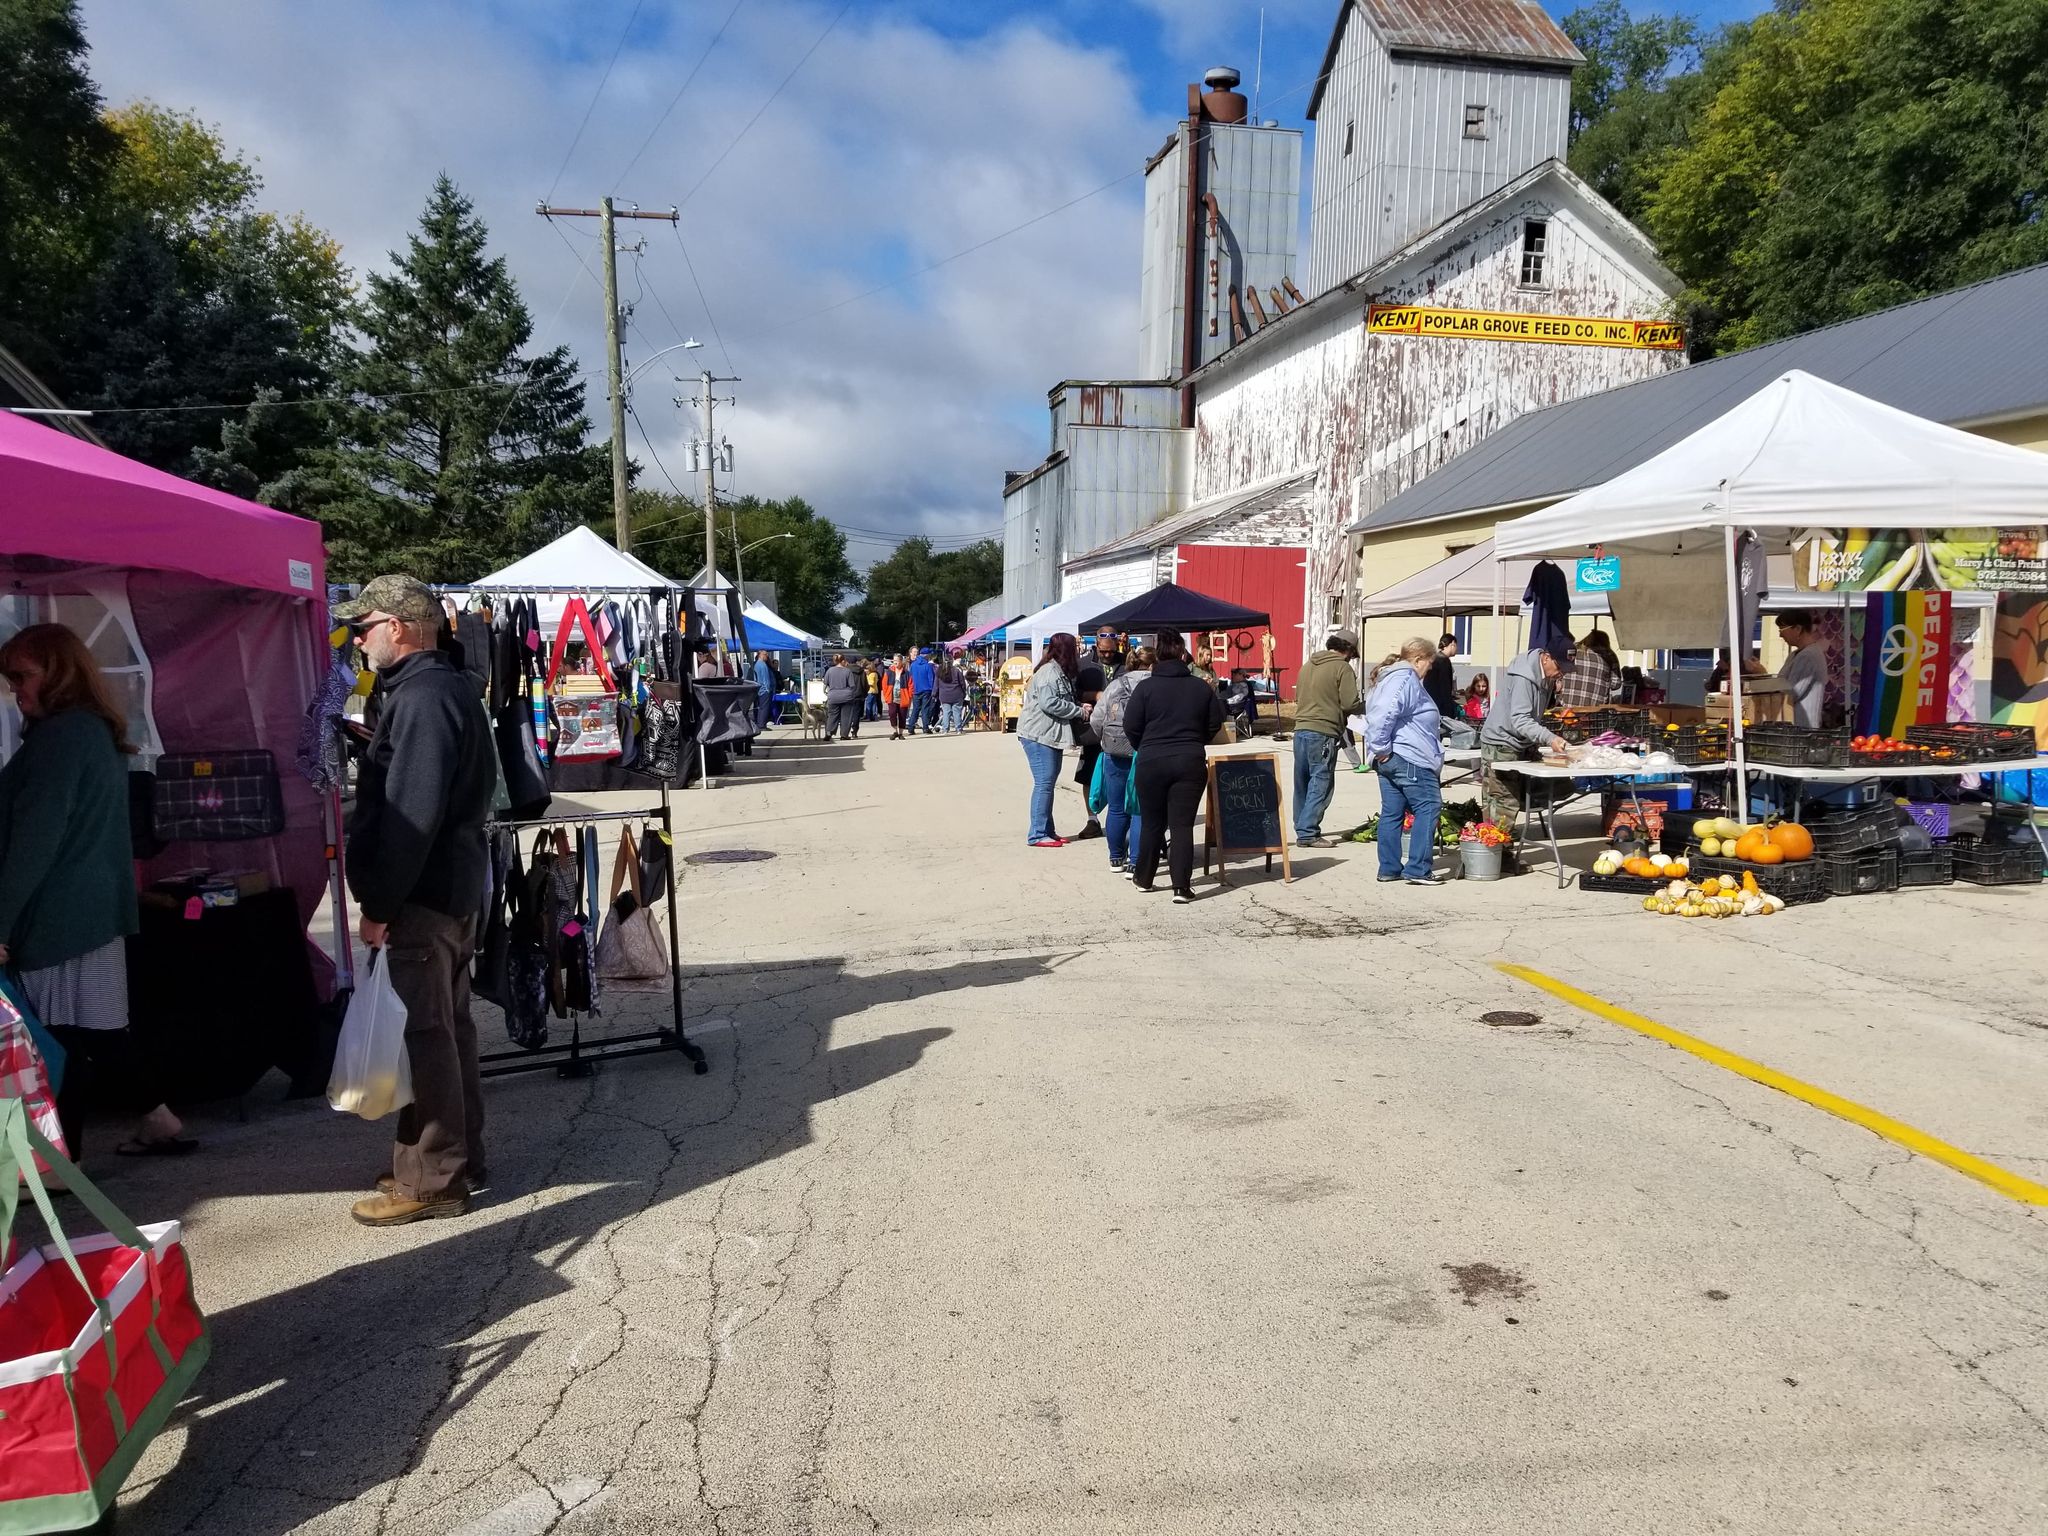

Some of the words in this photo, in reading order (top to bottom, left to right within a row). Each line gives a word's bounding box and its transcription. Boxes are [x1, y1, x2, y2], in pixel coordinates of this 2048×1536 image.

[1372, 311, 1420, 328] KENT
[1424, 315, 1478, 331] POPLAR
[1483, 319, 1529, 334] GROVE
[1534, 322, 1571, 336] FEED
[1575, 324, 1597, 338] CO.
[1605, 326, 1630, 340] INC.
[1636, 326, 1681, 343] KENT
[1984, 558, 1992, 568] &
[1993, 558, 2016, 568] Chris
[1918, 593, 1941, 707] PEACE
[1224, 792, 1266, 811] CORN
